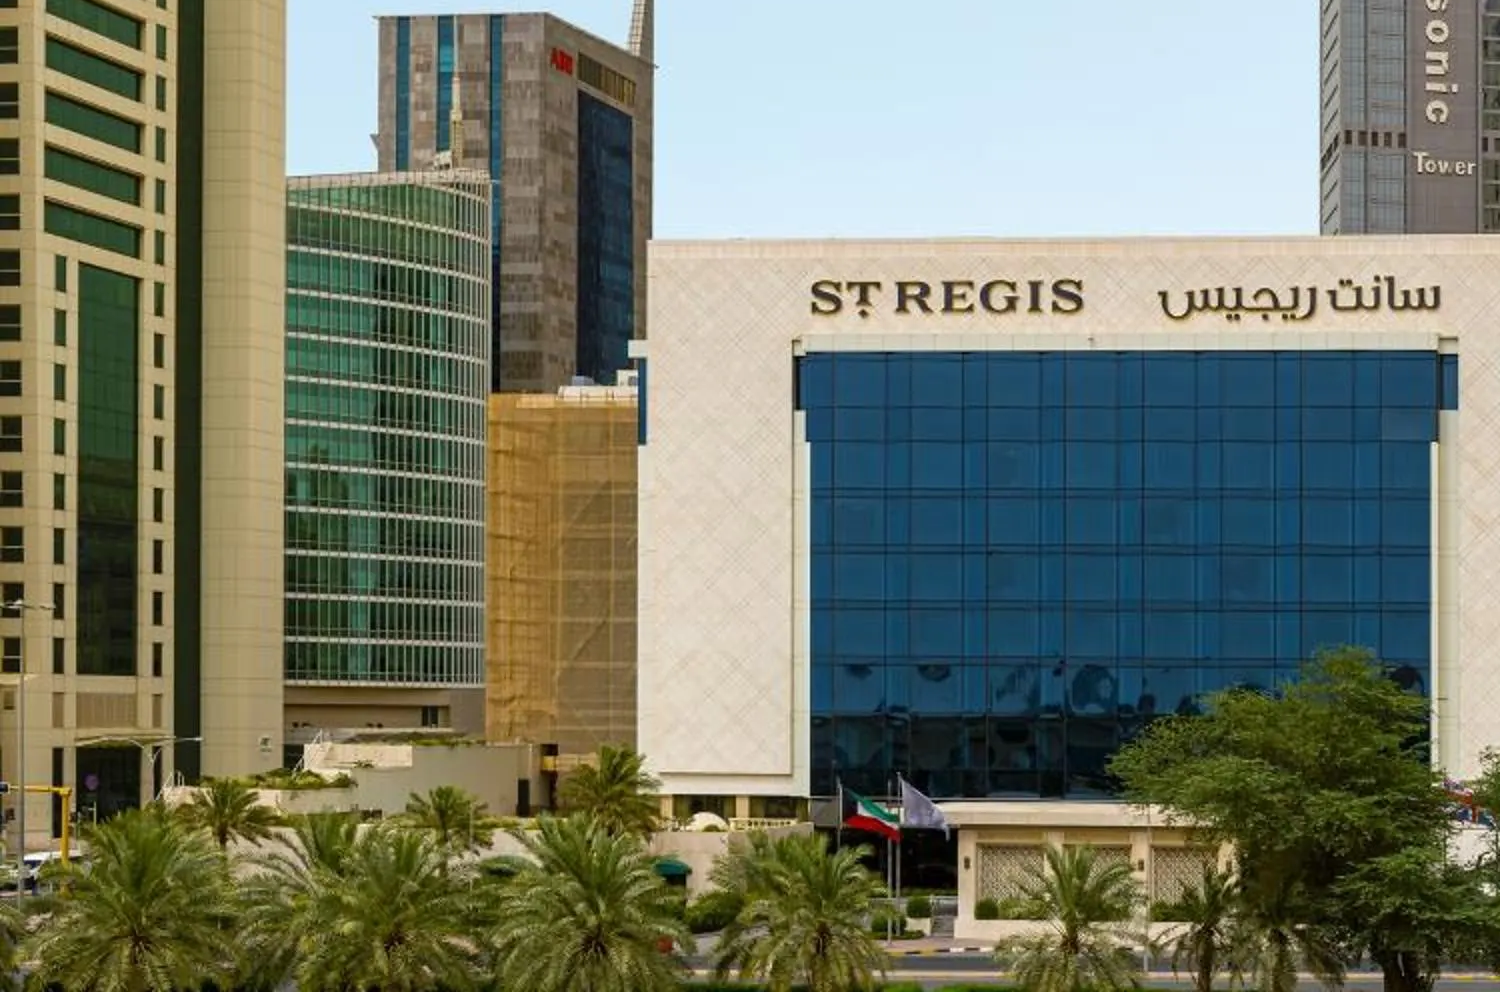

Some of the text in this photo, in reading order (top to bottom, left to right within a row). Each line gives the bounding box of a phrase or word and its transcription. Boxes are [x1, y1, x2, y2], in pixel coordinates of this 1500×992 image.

[1413, 151, 1476, 176] Tower
[894, 279, 1084, 315] REGIS
[1157, 275, 1441, 321] سانت ريجيس
